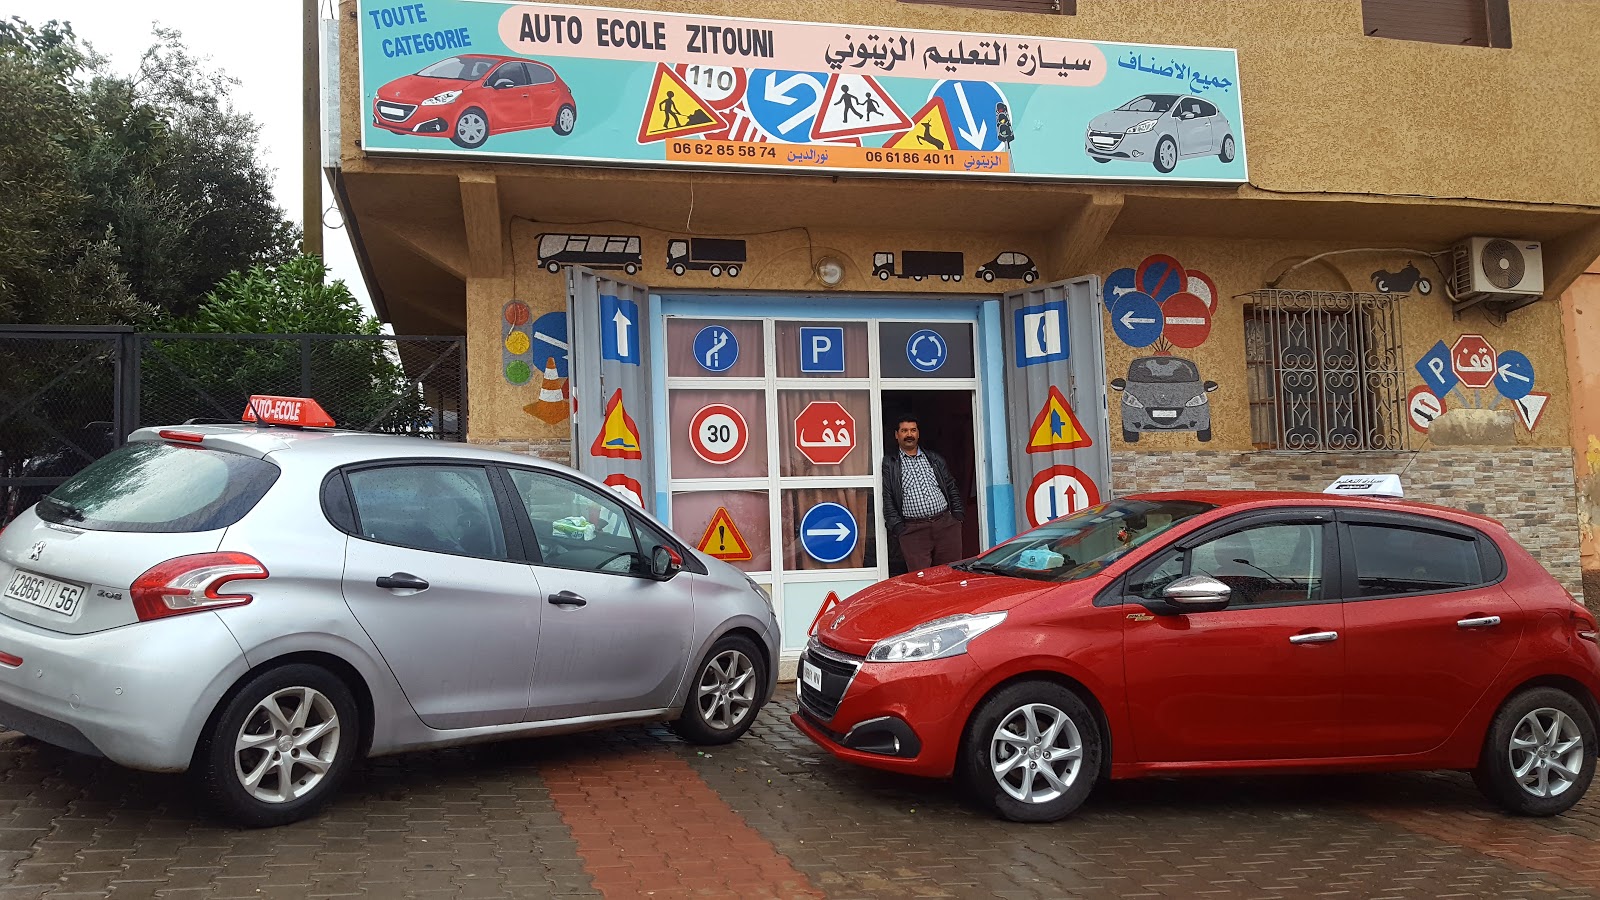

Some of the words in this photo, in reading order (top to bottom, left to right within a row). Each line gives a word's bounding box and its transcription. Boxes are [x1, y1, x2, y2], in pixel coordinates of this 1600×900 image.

[369, 3, 427, 29] TOUTE
[382, 27, 472, 58] CATEGORIE
[519, 13, 582, 44] AUTO
[596, 18, 666, 50] ECOLE
[686, 24, 774, 58] ZITOUNI
[824, 33, 915, 71] الزيتوني
[922, 39, 1008, 73] التعليم
[1016, 43, 1092, 78] سيارة
[689, 65, 733, 91] 110
[1189, 71, 1232, 93] جميع
[673, 142, 691, 154] 06
[695, 143, 713, 155] 62
[716, 144, 735, 156] 85
[738, 145, 756, 157] 58
[759, 146, 776, 158] 74
[865, 151, 883, 163] 06
[885, 151, 900, 163] 61
[903, 152, 920, 164] 86
[923, 153, 940, 165] 40
[943, 153, 955, 165] 11
[963, 154, 1002, 171] الزيتوني
[812, 335, 832, 364] P
[1456, 347, 1493, 372] قف
[1427, 357, 1446, 384] P
[247, 398, 301, 421] AUTO-ECOLE
[706, 424, 731, 443] 30
[800, 418, 852, 447] قف
[9, 573, 45, 601] 42866
[56, 586, 78, 611] 56
[97, 589, 122, 601] 208
